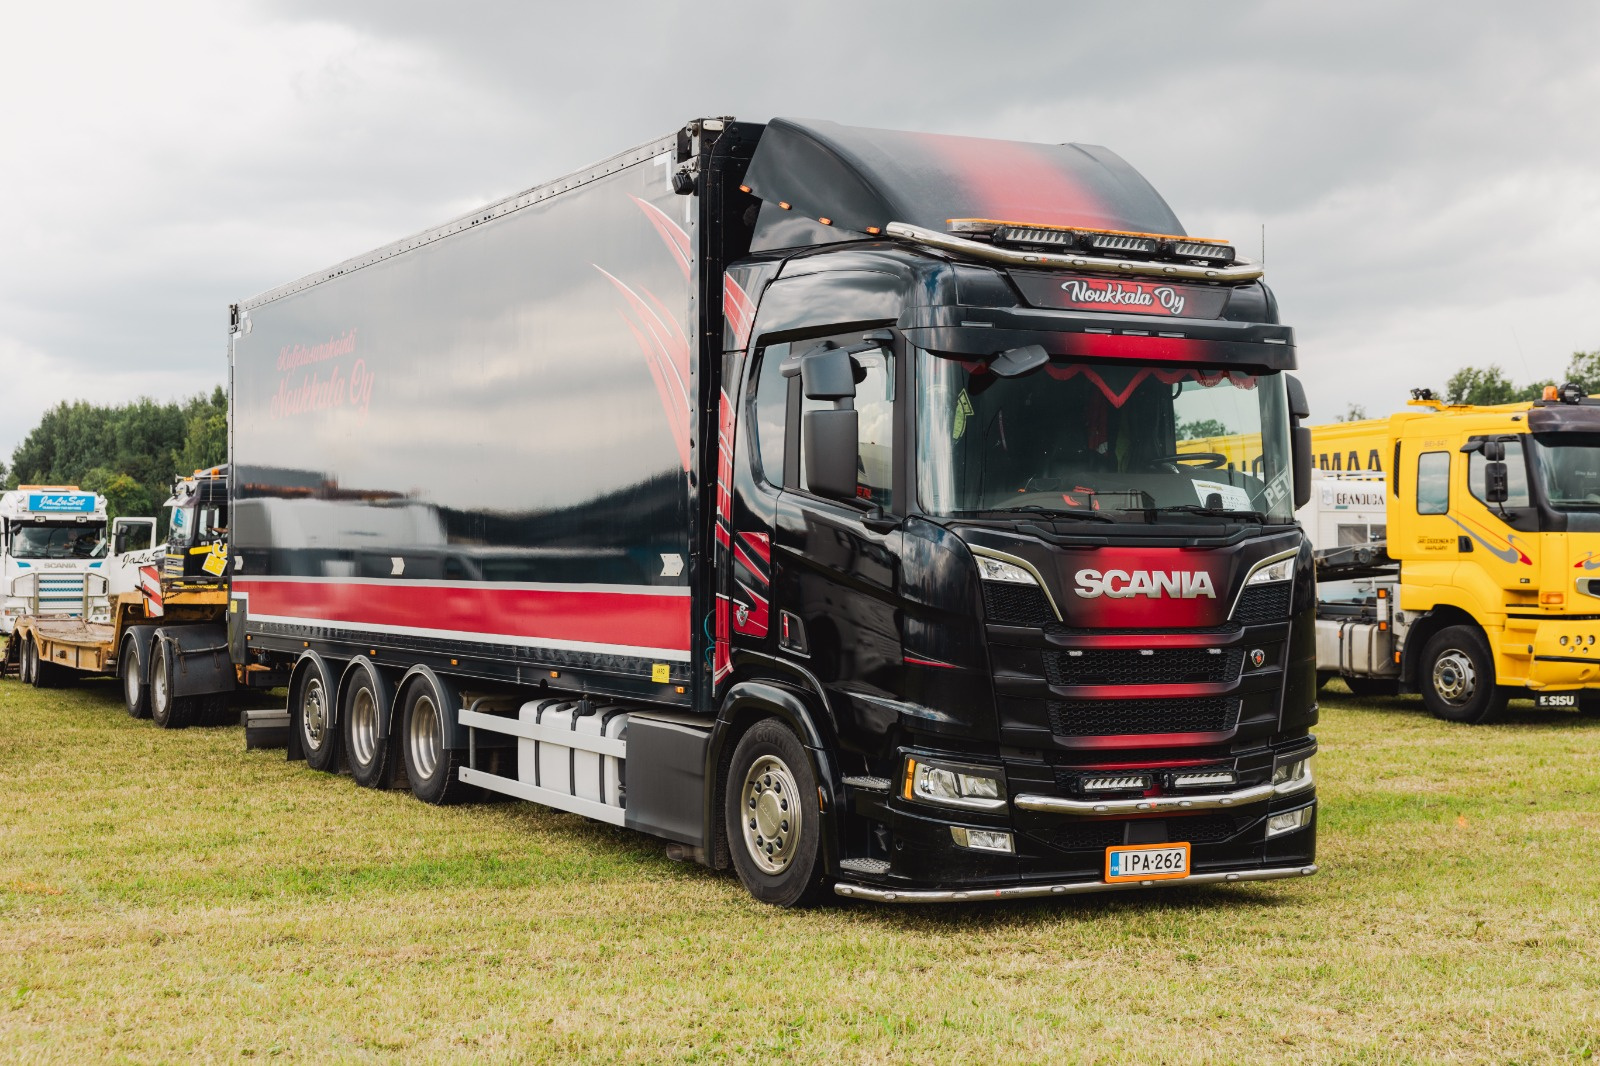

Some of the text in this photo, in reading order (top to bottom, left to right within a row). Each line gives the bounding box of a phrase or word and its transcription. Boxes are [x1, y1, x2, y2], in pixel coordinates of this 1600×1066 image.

[1061, 281, 1185, 314] Noukkala Oy
[1312, 449, 1384, 481] MAA
[1074, 568, 1217, 599] SCANIA
[1548, 695, 1575, 706] SISU
[1124, 851, 1182, 872] IPA-262
